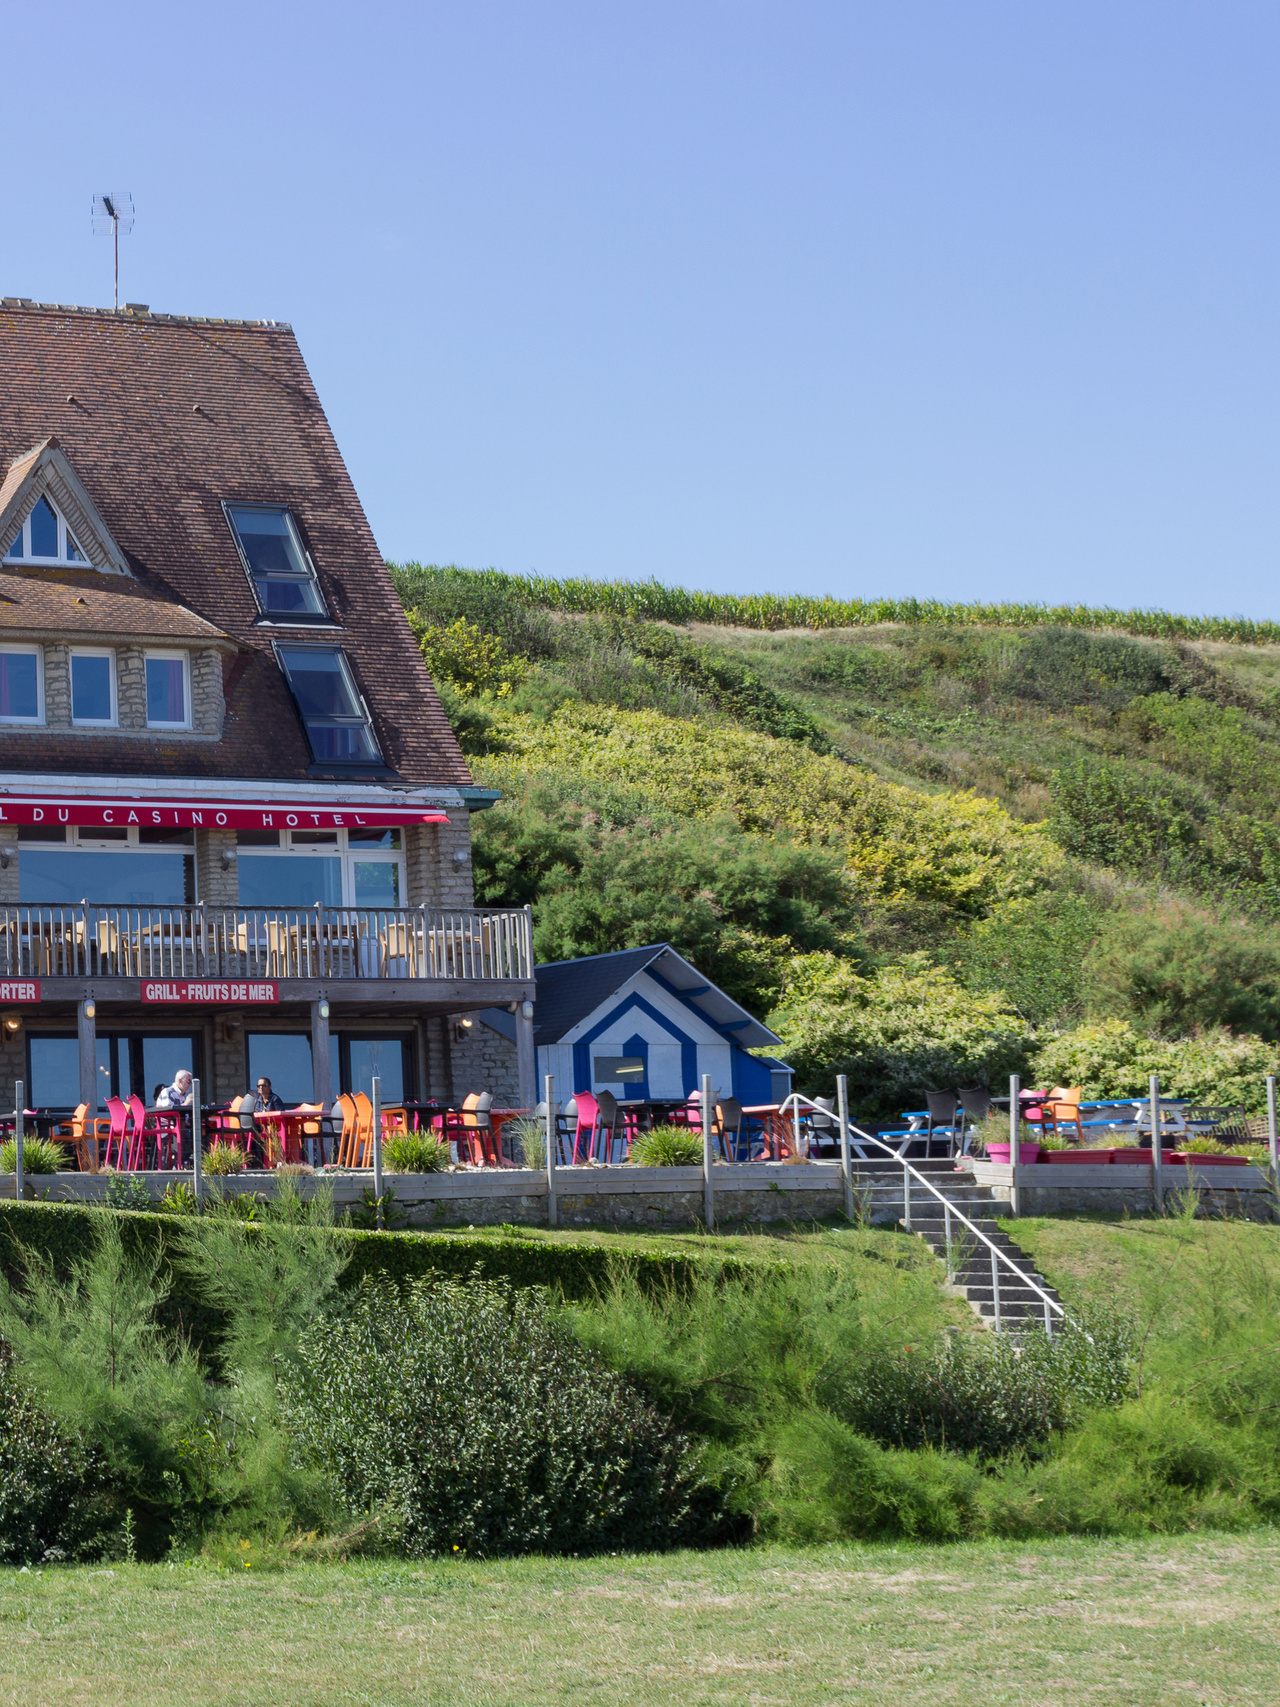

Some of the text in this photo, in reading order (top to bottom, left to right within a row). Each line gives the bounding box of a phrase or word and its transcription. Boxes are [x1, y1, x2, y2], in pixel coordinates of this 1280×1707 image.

[32, 807, 69, 822] DU
[102, 809, 228, 825] CASINO
[262, 813, 366, 826] HOTEL
[145, 983, 180, 1000] GRILL
[187, 984, 229, 1001] FRUITS
[230, 984, 247, 1000] DE
[248, 984, 274, 1001] MER
